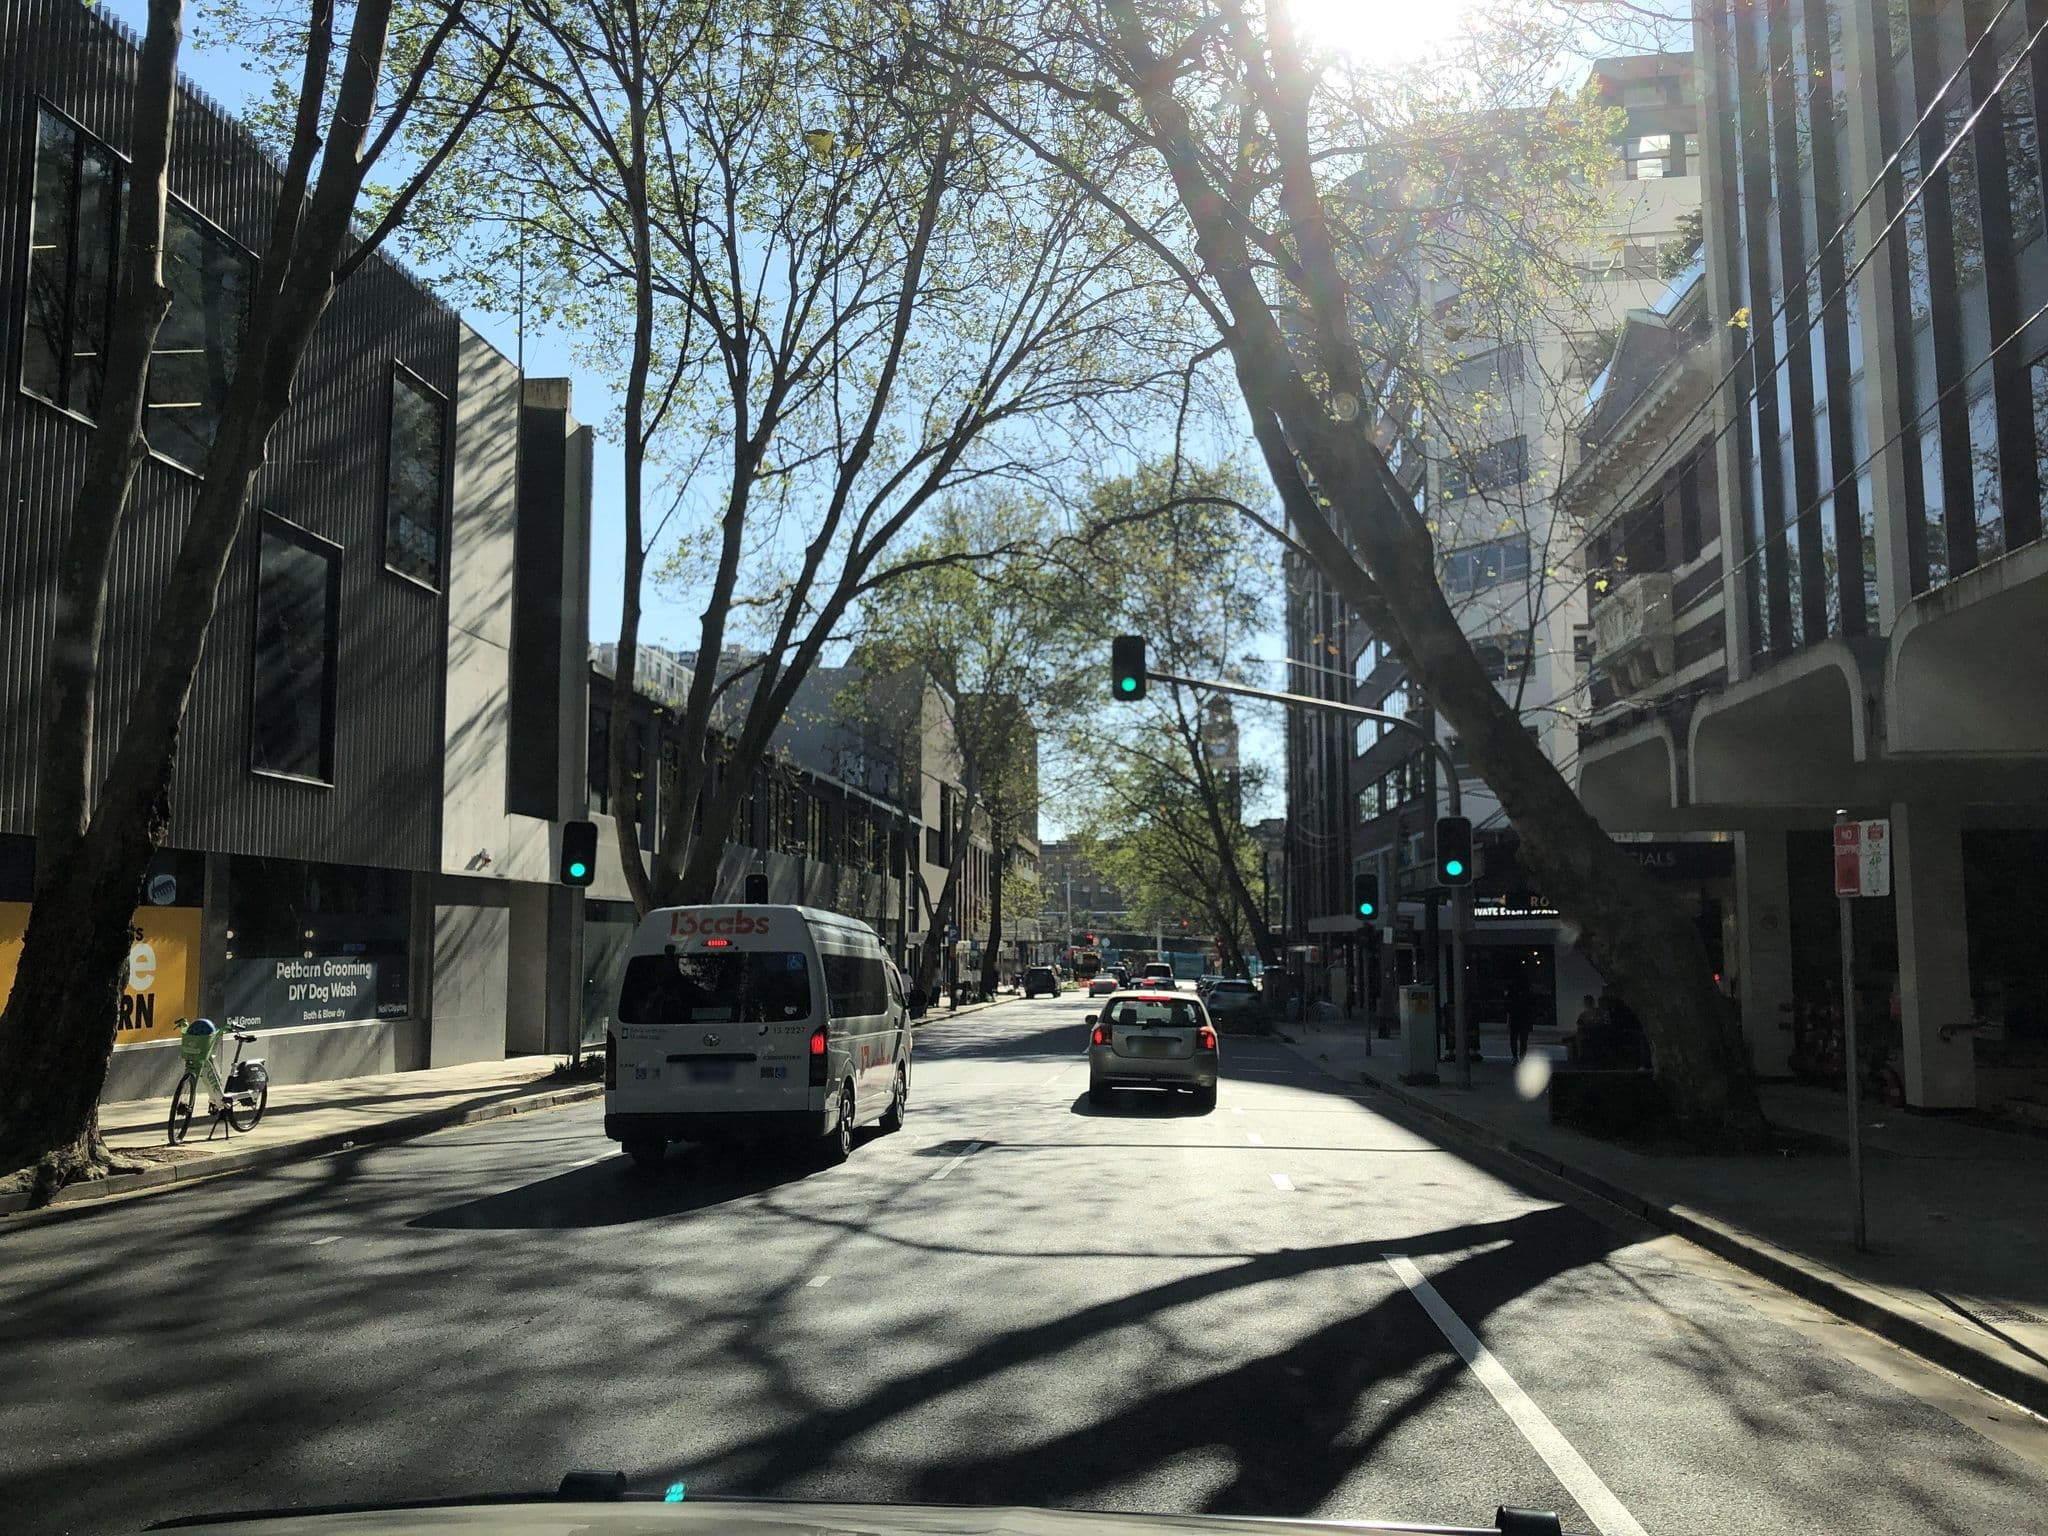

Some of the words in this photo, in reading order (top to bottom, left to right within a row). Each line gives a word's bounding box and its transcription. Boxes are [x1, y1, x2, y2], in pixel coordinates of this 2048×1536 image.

[669, 910, 770, 937] 13cabs
[276, 962, 321, 980] Petbarn
[323, 961, 373, 980] Grooming
[288, 983, 306, 1001] DIY
[308, 983, 329, 1003] Dog
[330, 981, 358, 998] Wash
[239, 1015, 262, 1027] Groom
[303, 1009, 316, 1020] Bath
